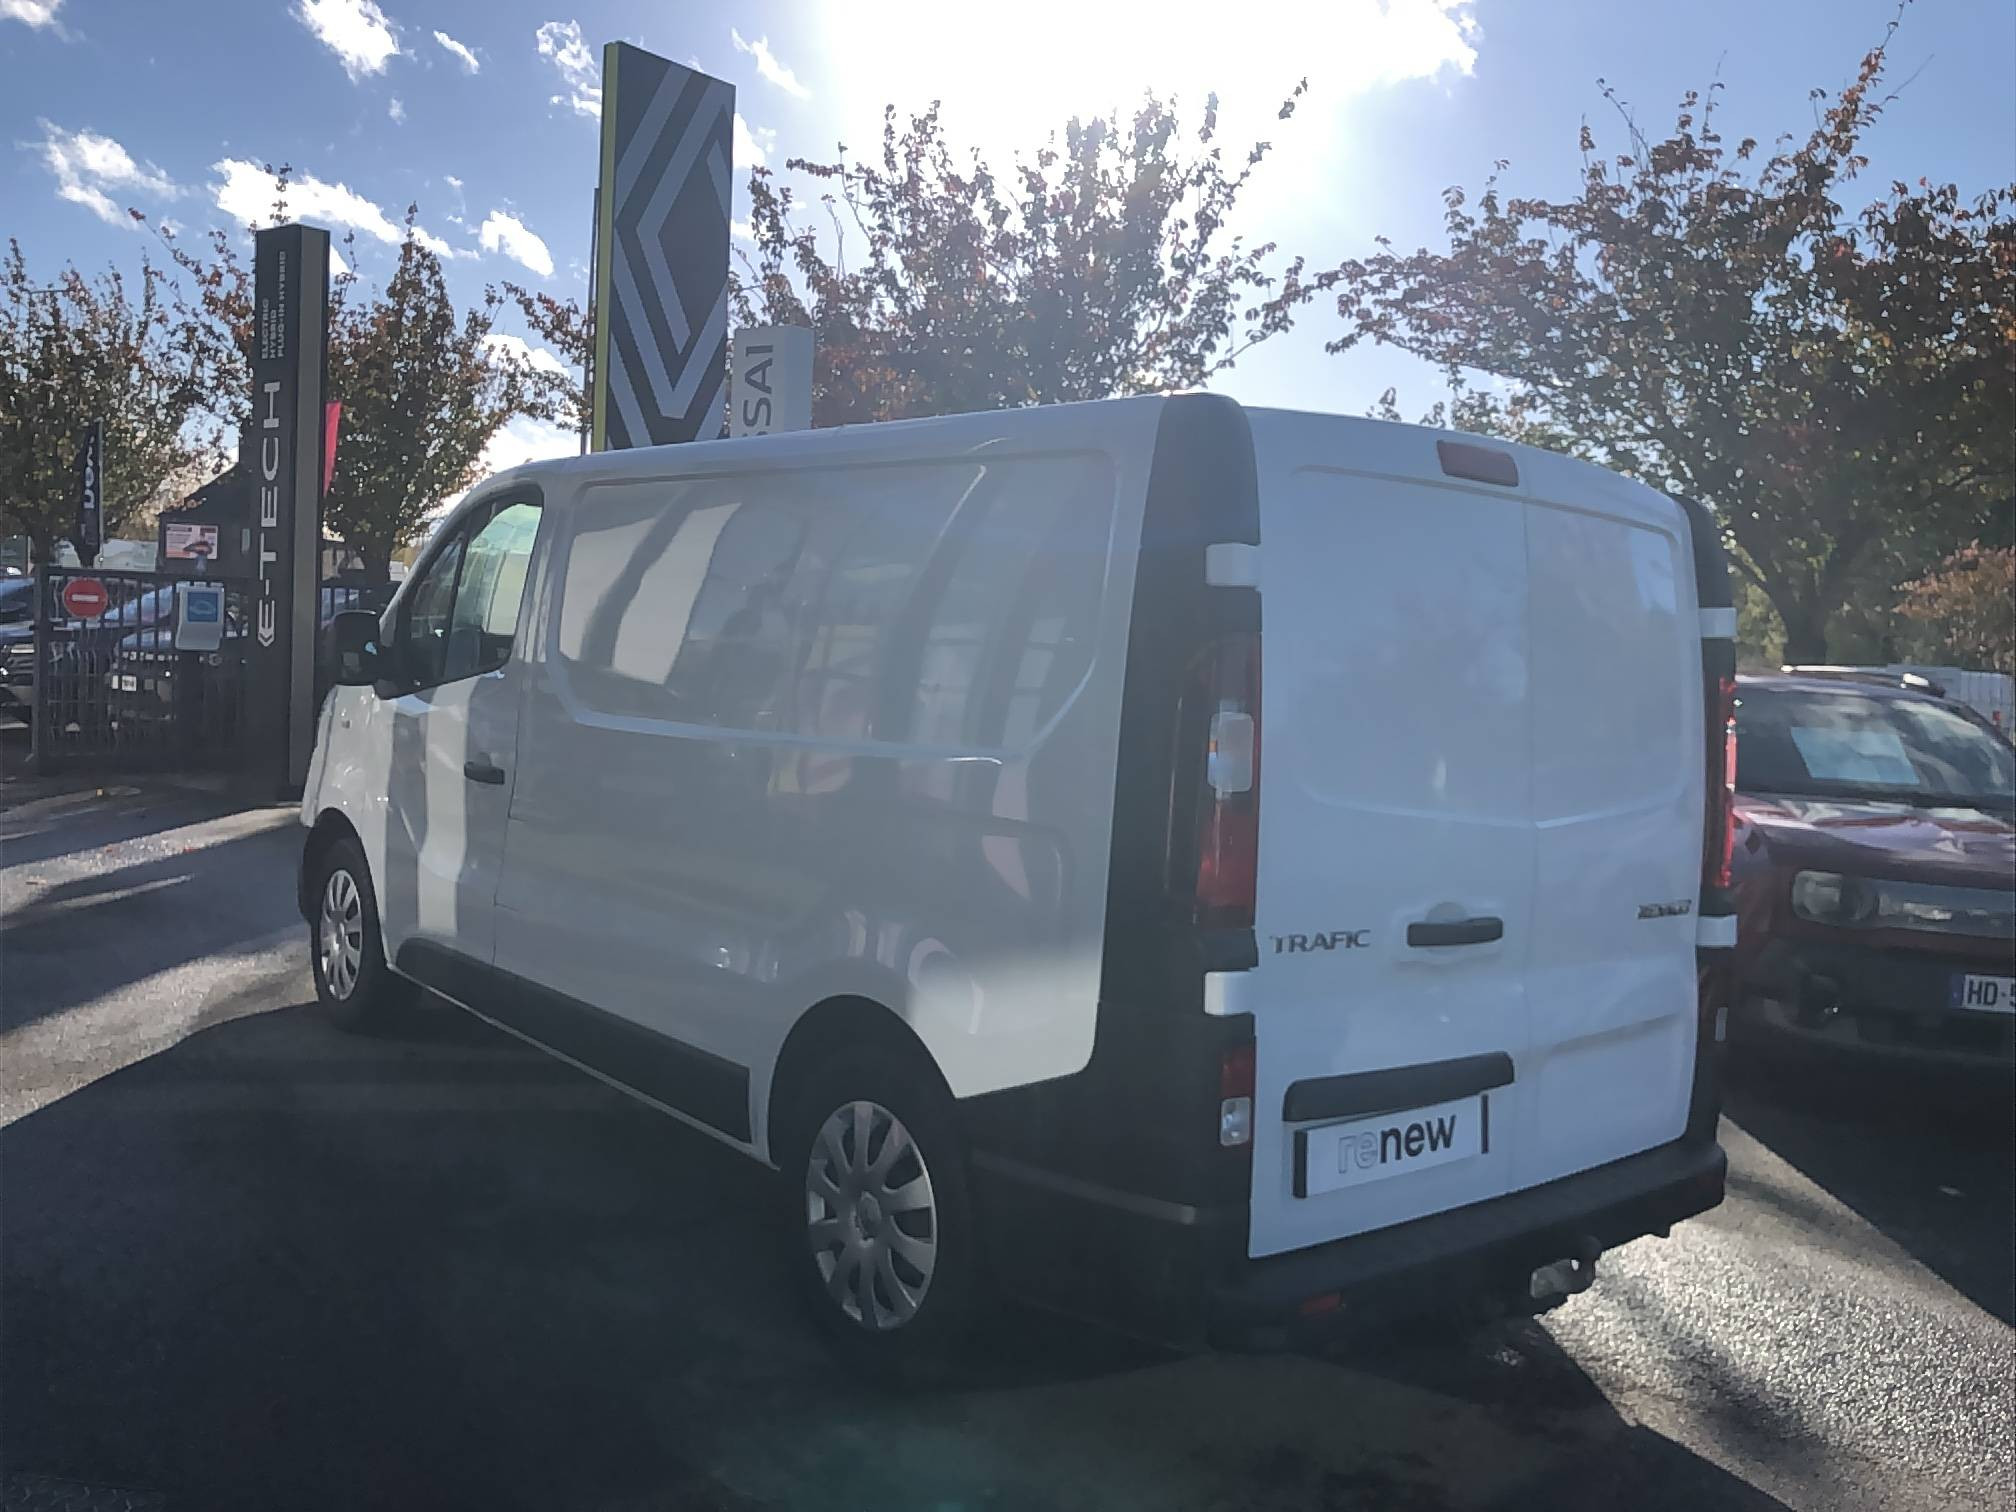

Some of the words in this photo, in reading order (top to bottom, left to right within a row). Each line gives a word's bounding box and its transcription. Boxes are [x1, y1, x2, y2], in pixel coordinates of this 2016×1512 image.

[742, 344, 774, 437] SAI
[257, 382, 281, 648] E-TECH
[1269, 928, 1372, 954] TRAFIC
[1337, 1114, 1457, 1175] renew
